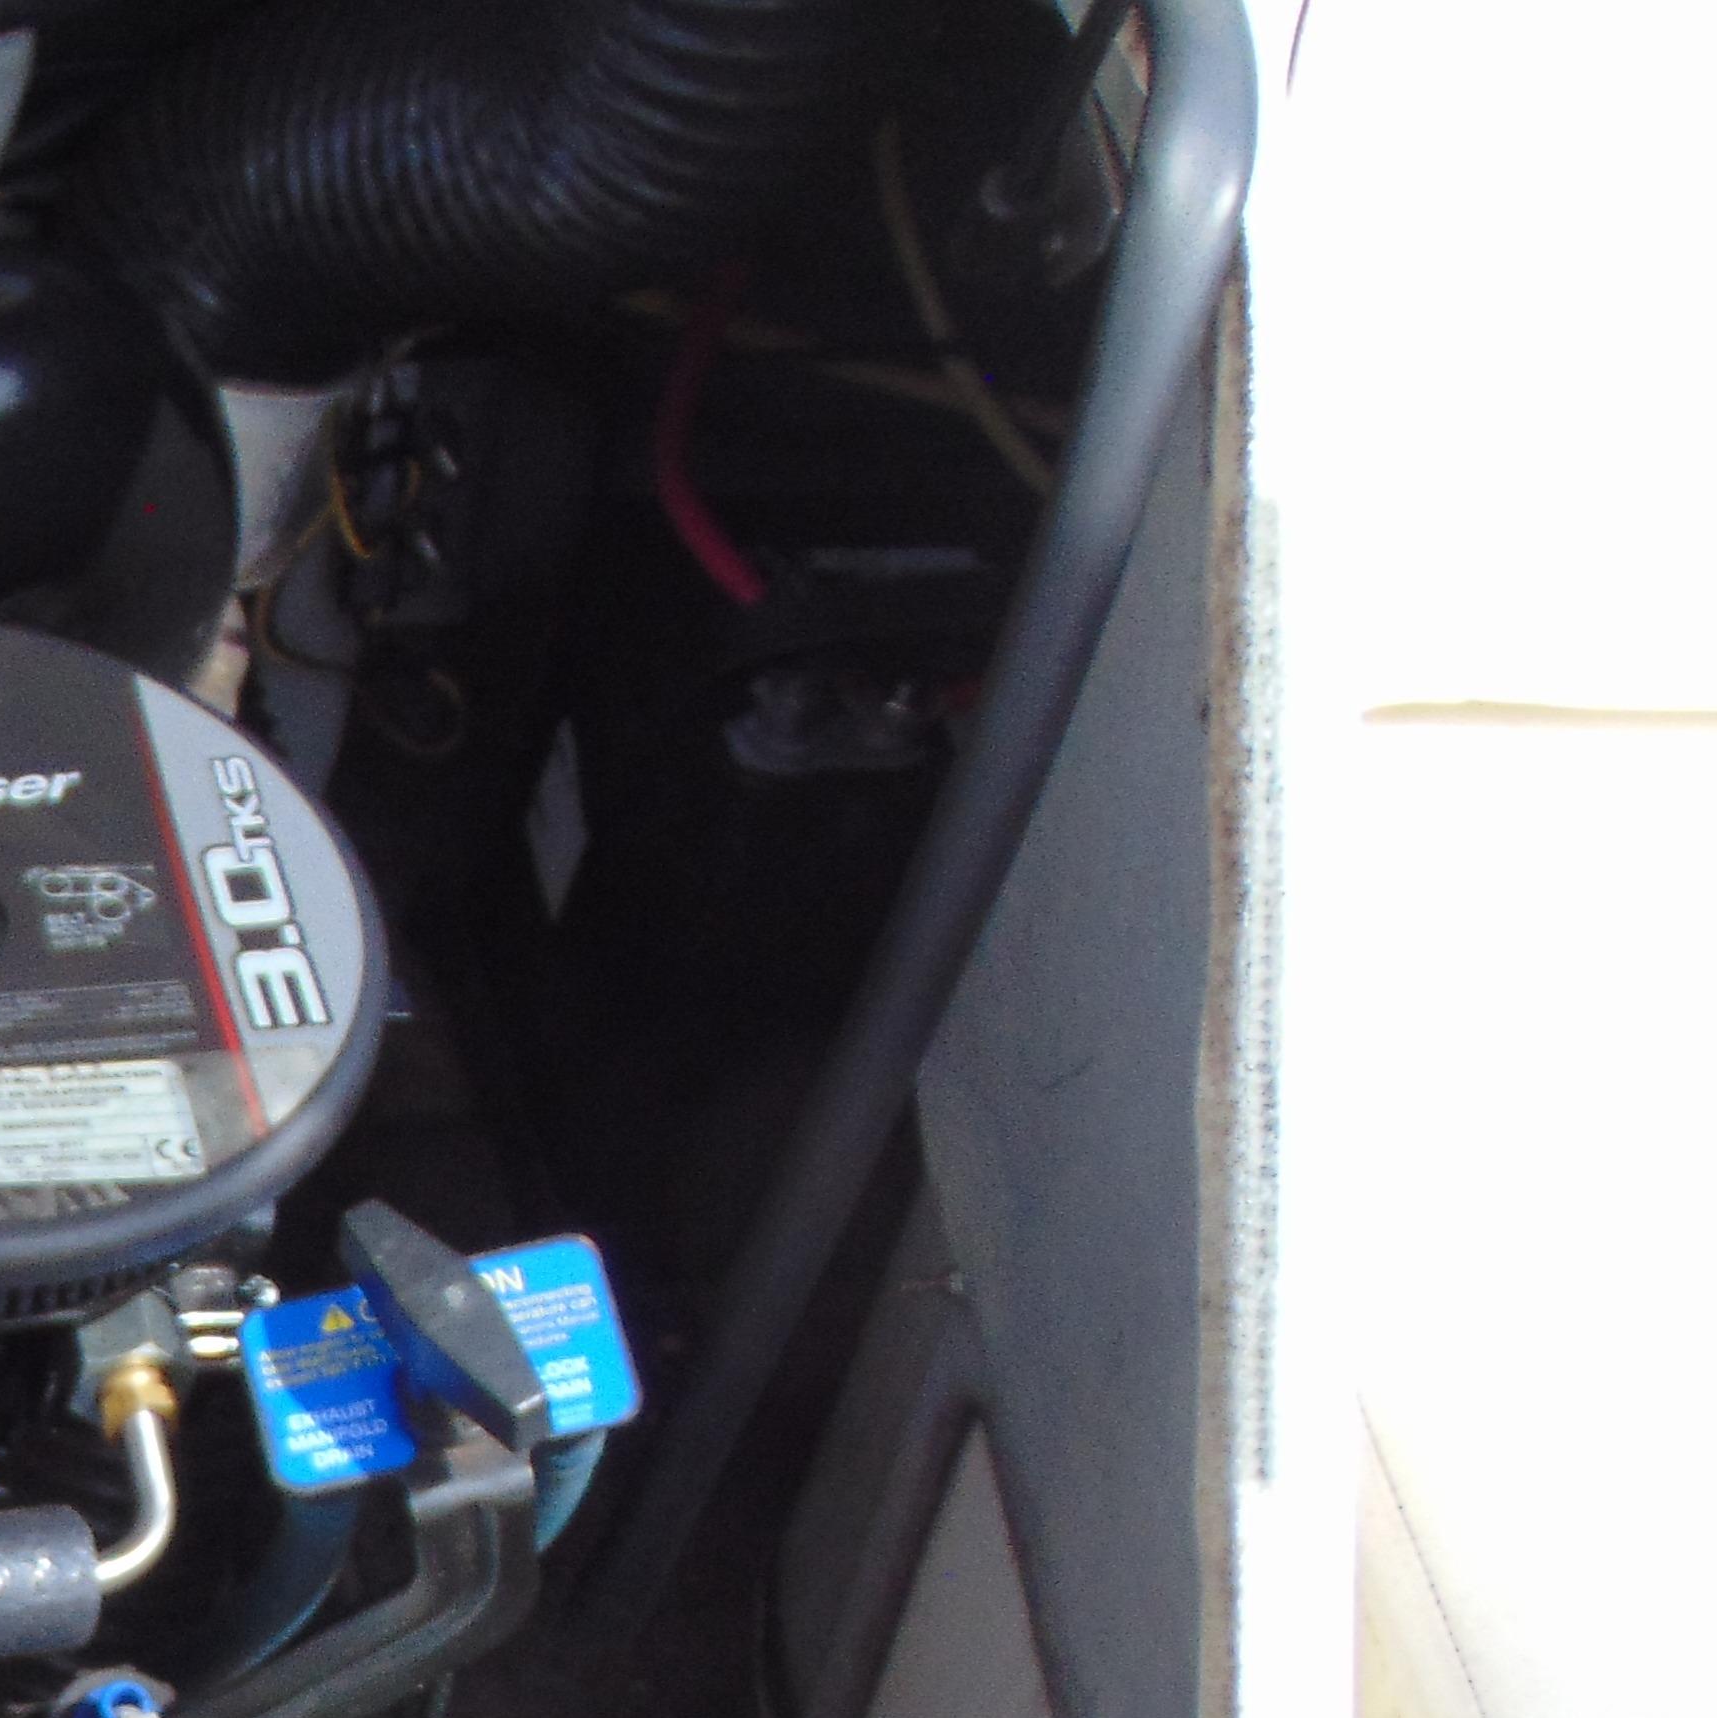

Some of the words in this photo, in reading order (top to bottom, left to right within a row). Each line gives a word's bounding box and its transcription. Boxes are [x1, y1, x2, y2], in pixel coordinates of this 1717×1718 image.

[287, 1398, 376, 1432] EXHAUST
[287, 1418, 389, 1453] MANIFOLD
[312, 1442, 376, 1470] DRAIN
